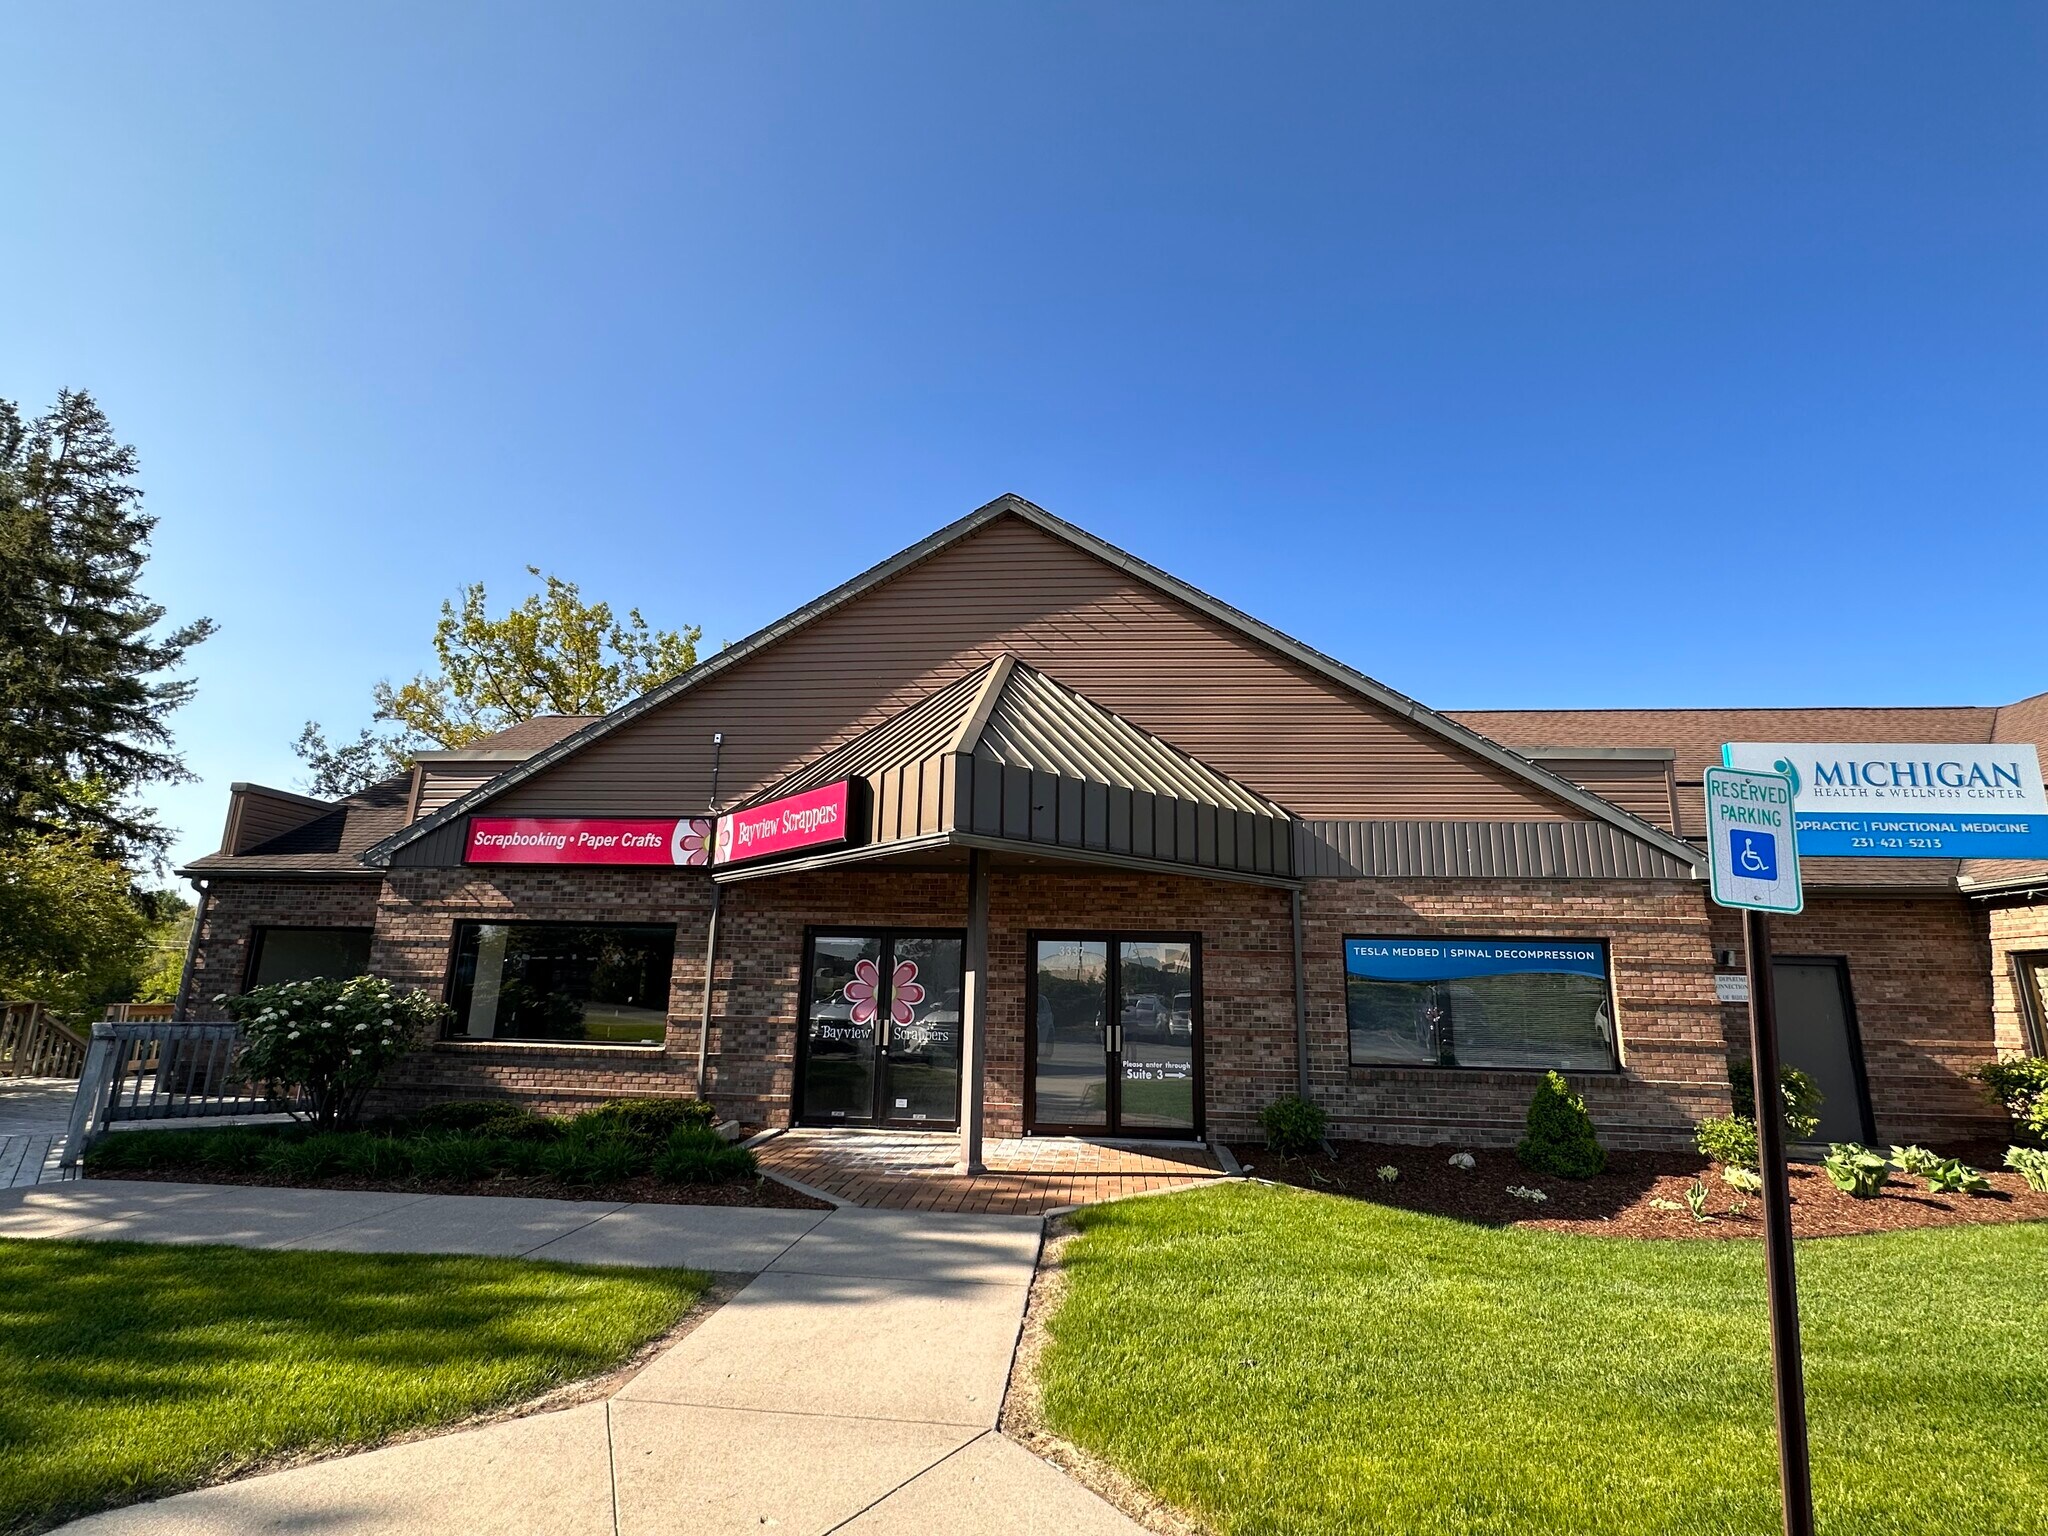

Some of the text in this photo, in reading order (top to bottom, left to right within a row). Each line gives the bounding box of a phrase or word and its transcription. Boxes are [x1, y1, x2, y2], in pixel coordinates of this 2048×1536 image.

[1814, 761, 2022, 788] MICHIGAN
[1711, 779, 1787, 805] RESERVED
[1814, 787, 2026, 799] HEALTH & WELLNESS CENTER
[1720, 804, 1782, 828] PARKING
[737, 802, 838, 846] Bayview Scrappers
[1871, 822, 1958, 834] FUNCTIONAL
[1961, 823, 2030, 834] MEDICINE
[474, 831, 566, 849] Scrapbooking
[578, 833, 618, 849] Paper
[621, 833, 663, 848] Crafts
[1851, 837, 1942, 849] 231-421-5213
[1059, 946, 1085, 957] 3337
[1354, 947, 1389, 956] TESLA
[1392, 948, 1440, 957] MEDBED
[1450, 948, 1491, 958] SPINAL
[1495, 949, 1595, 960] DECOMPRESSION
[822, 1025, 949, 1041] Bayview Scrappers
[1122, 1060, 1190, 1070] Please enter through
[1126, 1069, 1164, 1080] Suite 3
